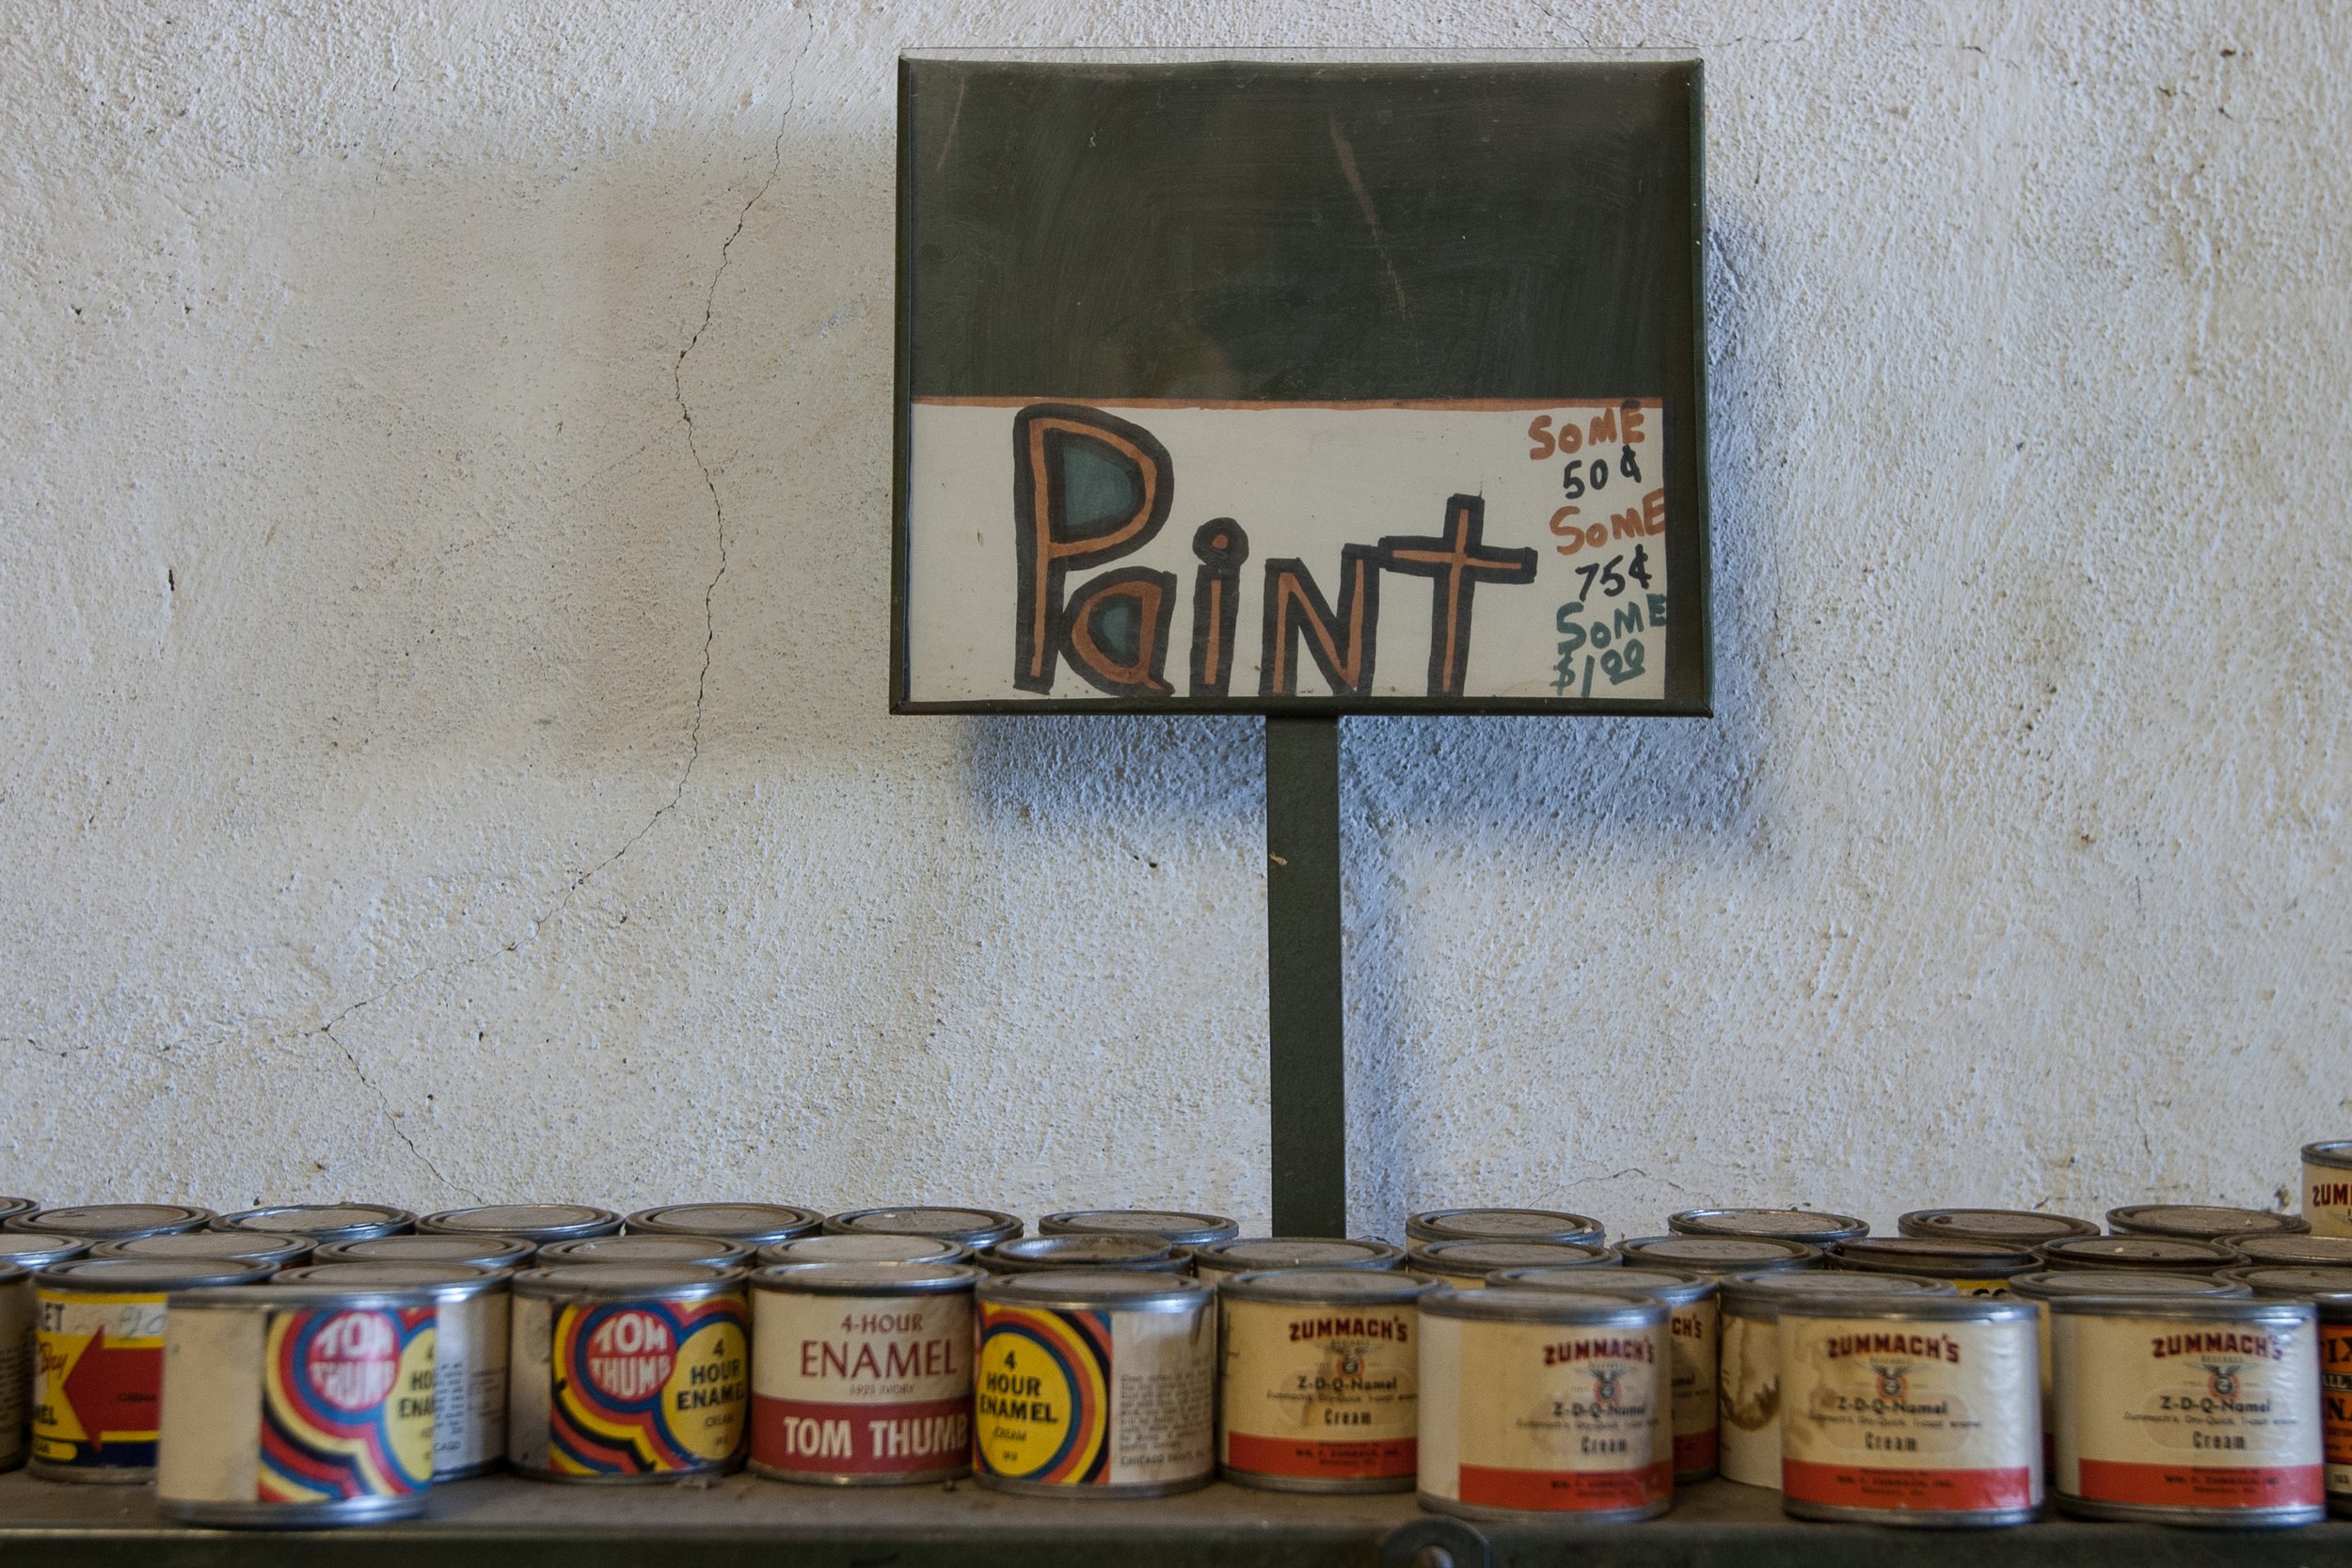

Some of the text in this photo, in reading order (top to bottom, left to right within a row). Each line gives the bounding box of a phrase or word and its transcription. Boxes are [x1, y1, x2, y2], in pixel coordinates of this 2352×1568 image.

[2312, 1182, 2352, 1207] ZUM
[594, 1313, 668, 1353] TOM
[841, 1313, 924, 1334] 4-HOUR
[1290, 1315, 1408, 1342] ZUMMACH'S
[1672, 1315, 1702, 1338] CH'S
[713, 1338, 725, 1357] 4
[802, 1339, 958, 1379] ENAMEL
[1543, 1336, 1655, 1365] ZUMMACH'S
[1827, 1332, 1961, 1364] ZUMMACH'S
[2152, 1332, 2283, 1361] ZUMMACH'S
[691, 1358, 740, 1386] HOUR
[1004, 1350, 1017, 1370] 4
[411, 1370, 435, 1390] HO
[588, 1355, 672, 1398] THUMB
[986, 1372, 1042, 1397] HOUR
[977, 1395, 1059, 1424] ENAMEL
[1324, 1408, 1372, 1425] Cream
[783, 1413, 968, 1458] TOM THUMB
[1581, 1435, 1628, 1454] Cream
[1865, 1431, 1917, 1451] Cream
[2193, 1430, 2247, 1449] Cream
